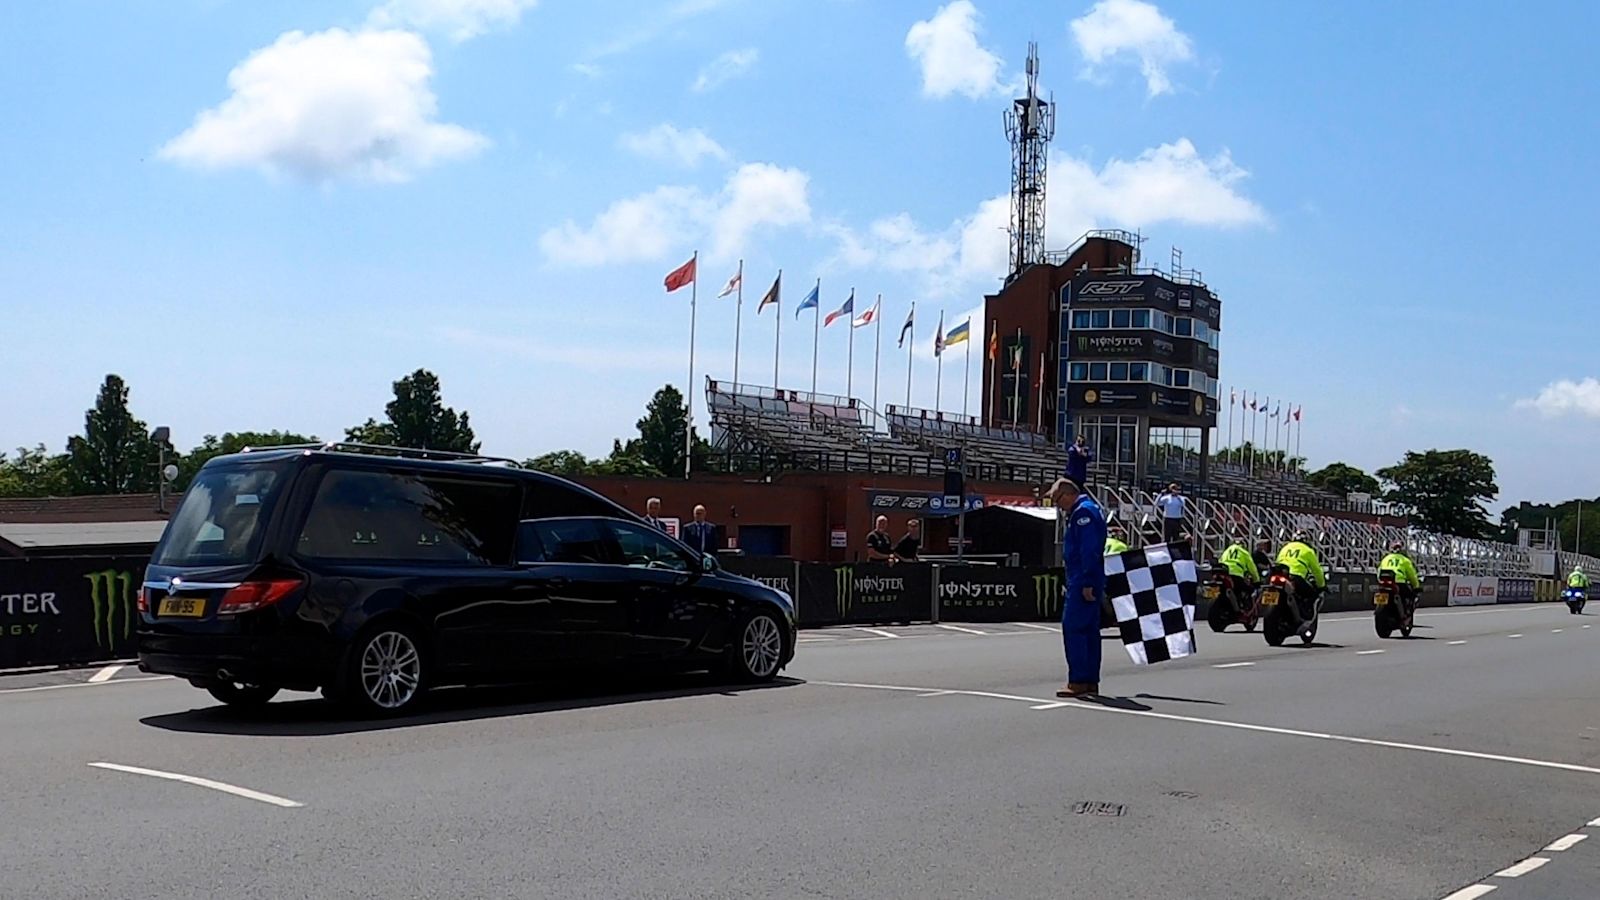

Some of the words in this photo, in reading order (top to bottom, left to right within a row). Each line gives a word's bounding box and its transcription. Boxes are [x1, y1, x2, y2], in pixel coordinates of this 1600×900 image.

[1079, 280, 1144, 295] RST
[1090, 336, 1143, 347] MONSTER
[1286, 549, 1300, 558] M
[854, 576, 904, 593] MONSTER
[0, 623, 38, 636] GY
